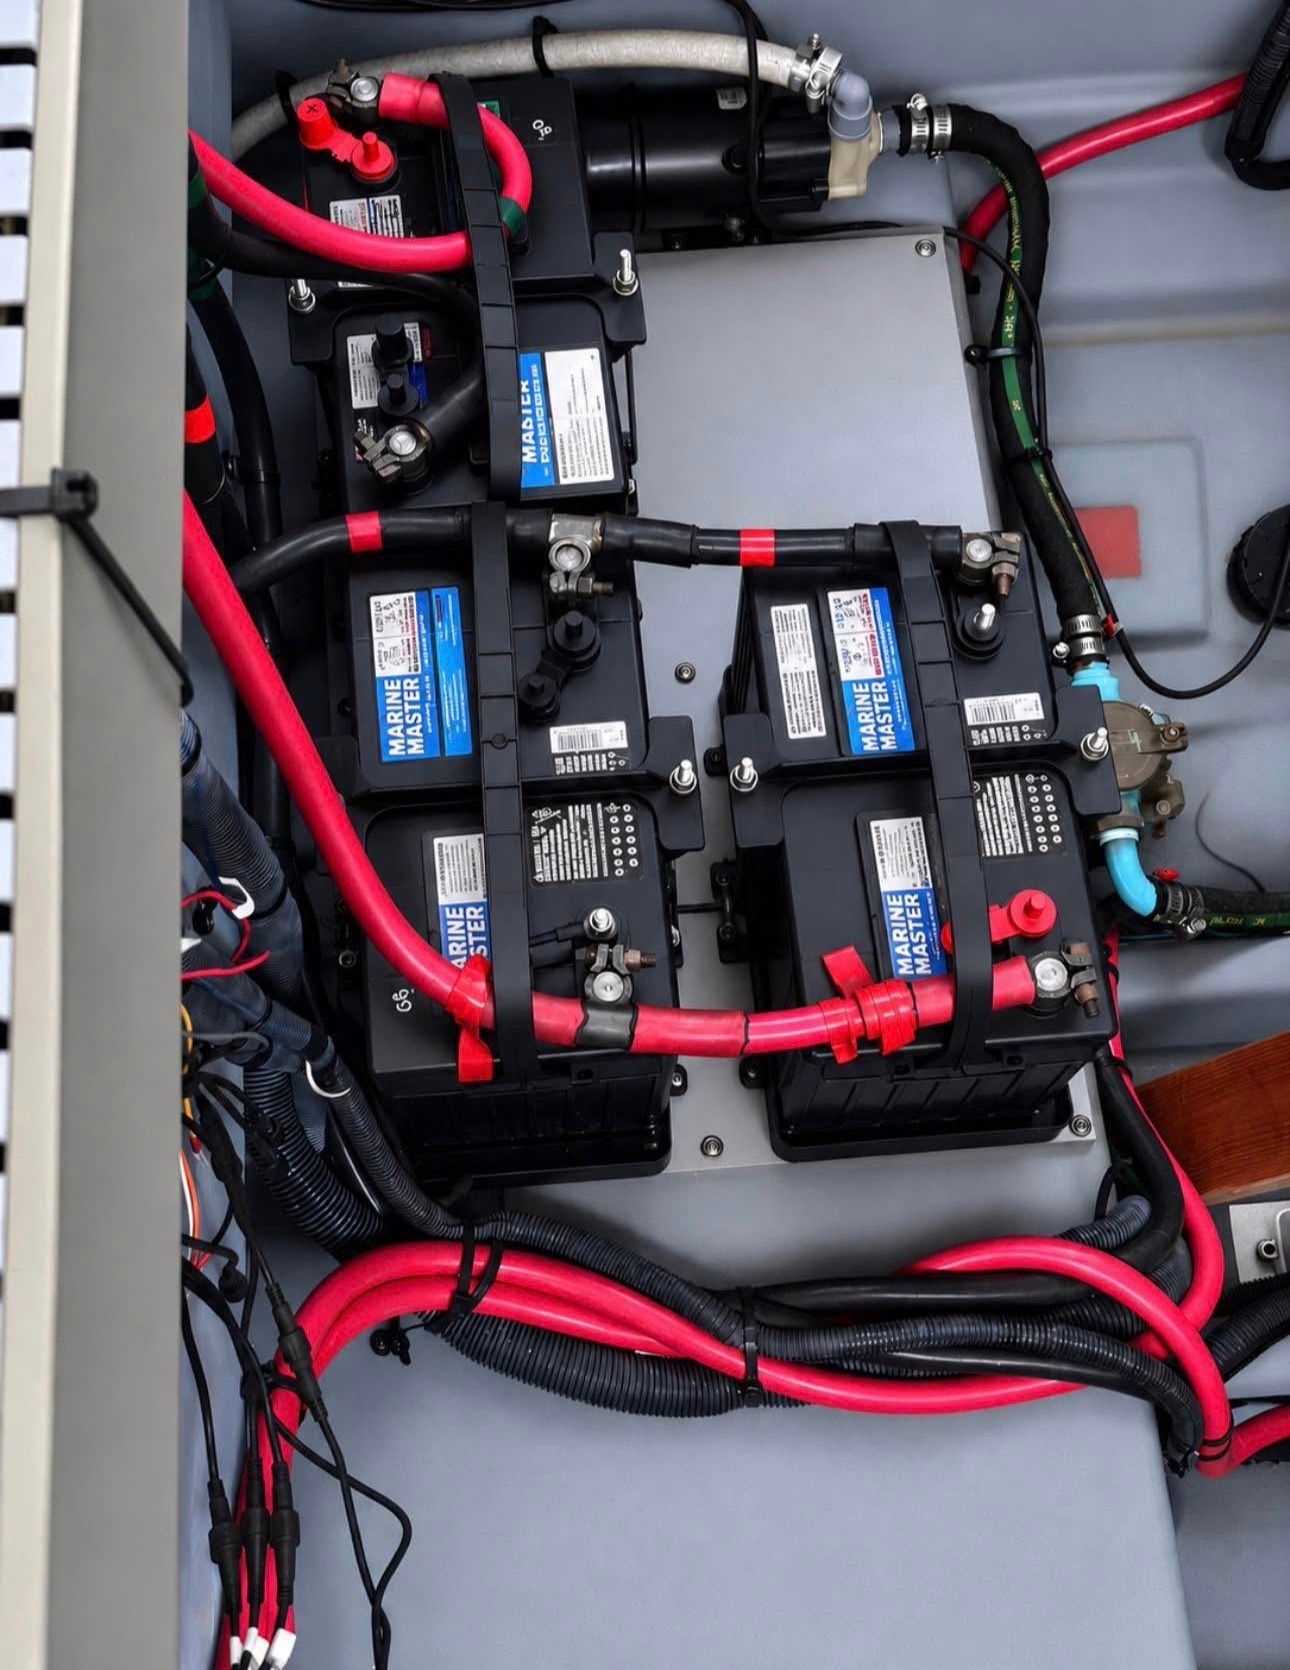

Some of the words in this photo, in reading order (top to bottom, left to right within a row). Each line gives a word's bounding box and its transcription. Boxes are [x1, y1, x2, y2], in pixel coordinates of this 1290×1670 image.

[384, 679, 406, 756] MARINE
[403, 677, 424, 754] MASTER
[852, 682, 879, 751] MARINE
[872, 680, 897, 750] MASTER
[445, 906, 467, 969] ARINE
[466, 906, 488, 957] STER
[886, 894, 915, 975] MARINE
[904, 893, 932, 974] MASTER
